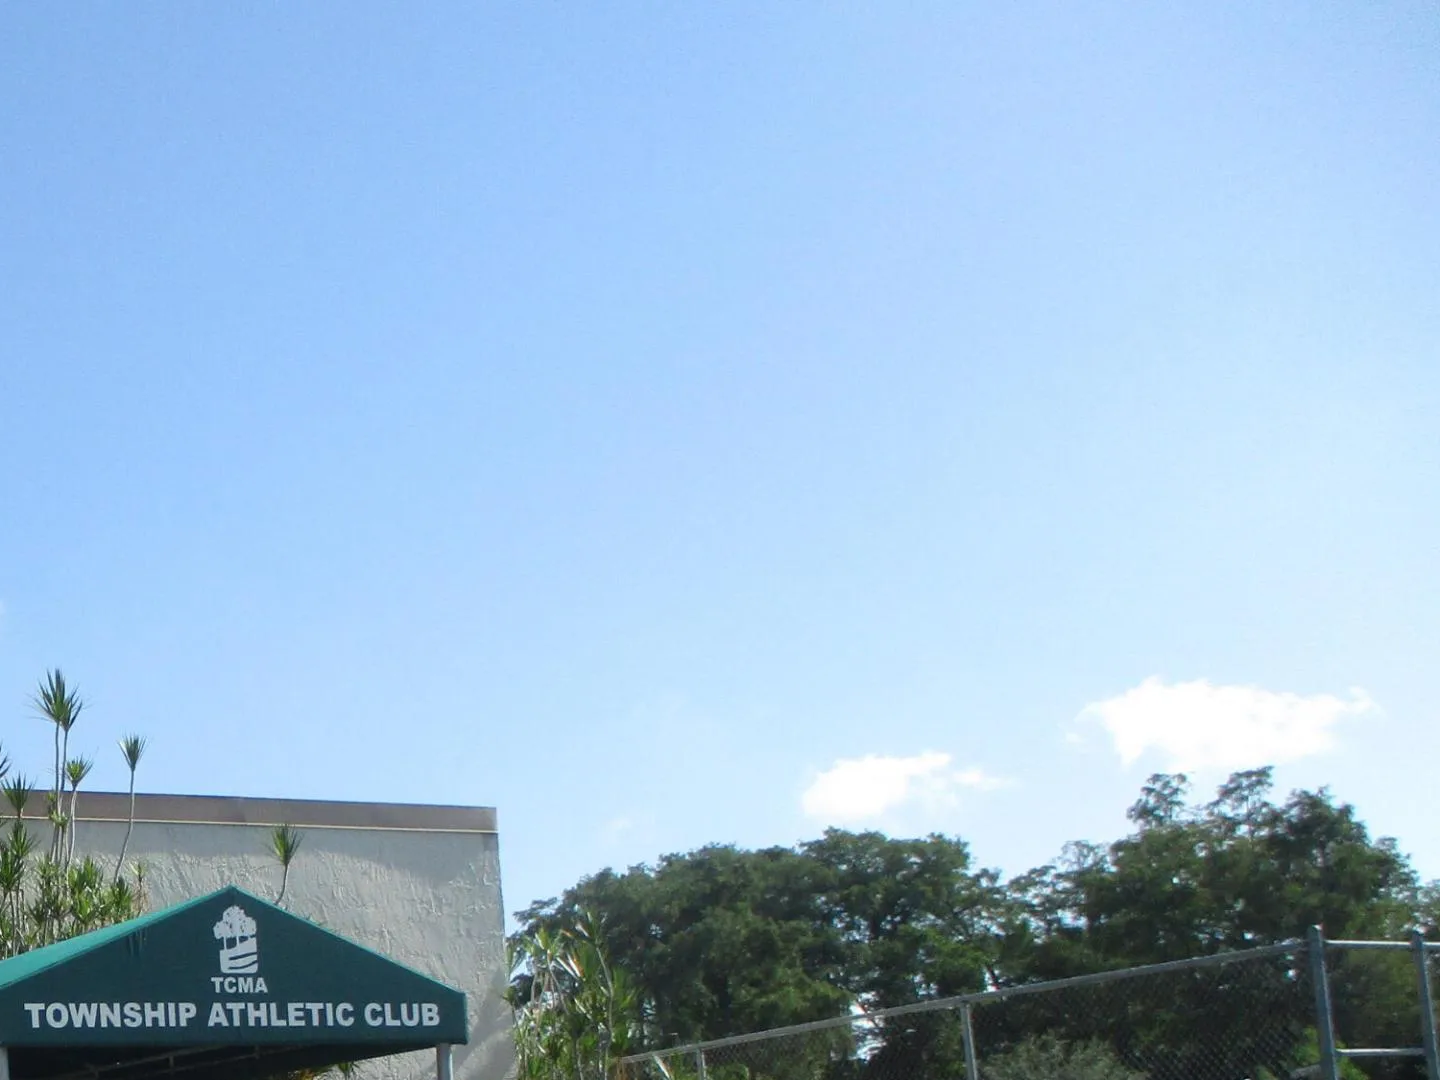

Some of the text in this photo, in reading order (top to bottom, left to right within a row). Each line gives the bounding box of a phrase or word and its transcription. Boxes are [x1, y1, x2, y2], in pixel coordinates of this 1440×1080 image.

[211, 976, 268, 993] TCMA
[24, 1002, 441, 1028] TOWNSHIP ATHLETIC CLUB
